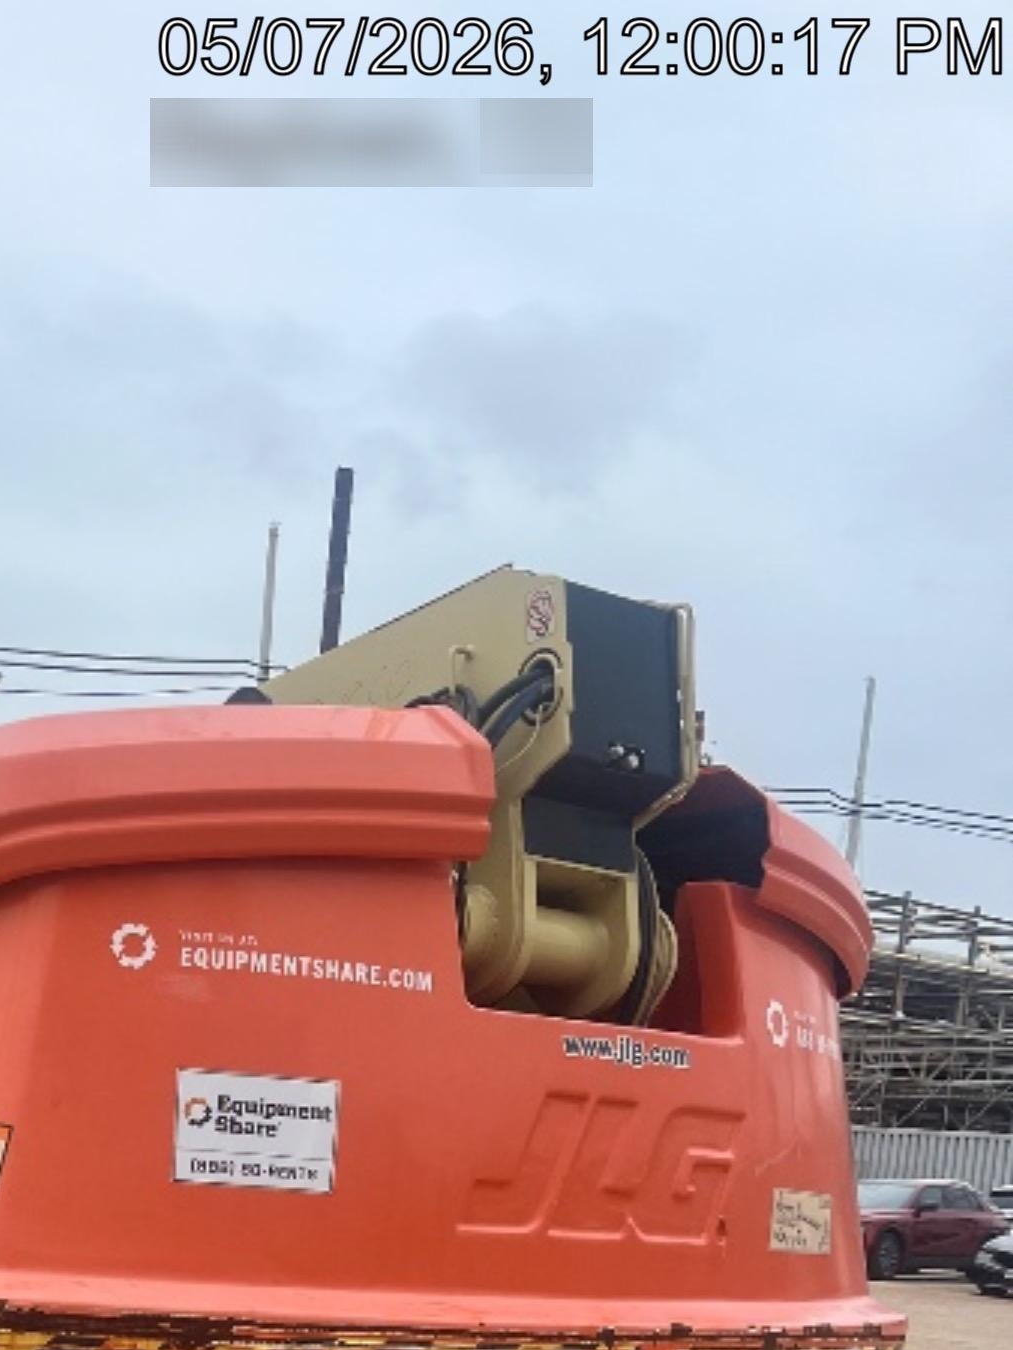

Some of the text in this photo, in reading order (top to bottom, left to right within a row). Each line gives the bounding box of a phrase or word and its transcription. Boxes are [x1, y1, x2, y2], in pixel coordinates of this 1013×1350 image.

[180, 947, 433, 992] EQUIPMENTSHARE.COM
[563, 1035, 690, 1067] www.jlg.com
[217, 1094, 332, 1122] Equipment
[214, 1115, 278, 1138] Share
[456, 1090, 747, 1246] JLG
